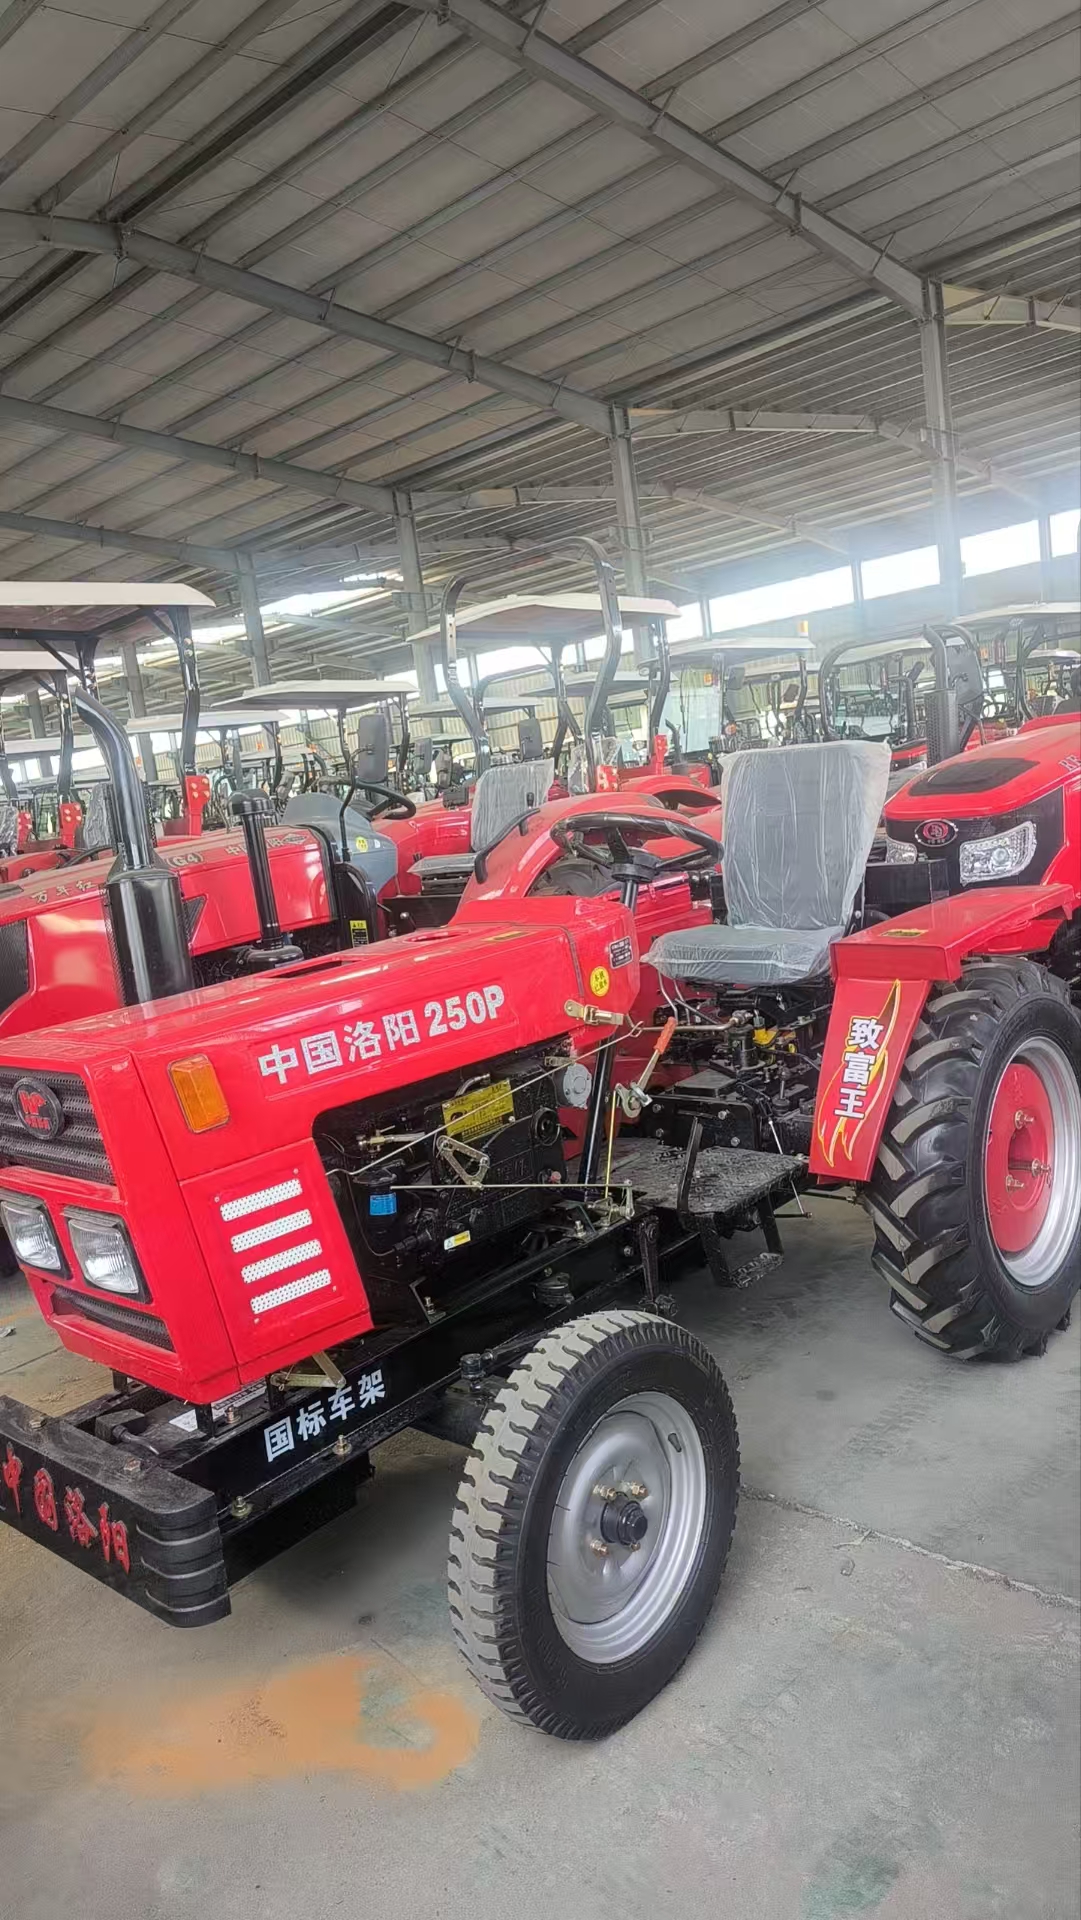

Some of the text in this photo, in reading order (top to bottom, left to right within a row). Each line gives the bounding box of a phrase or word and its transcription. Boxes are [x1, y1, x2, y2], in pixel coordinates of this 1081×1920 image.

[31, 880, 96, 904] 万年红
[258, 984, 505, 1085] 中国洛阳 250P
[834, 1018, 884, 1119] 致富王
[263, 1369, 386, 1463] 国标车架
